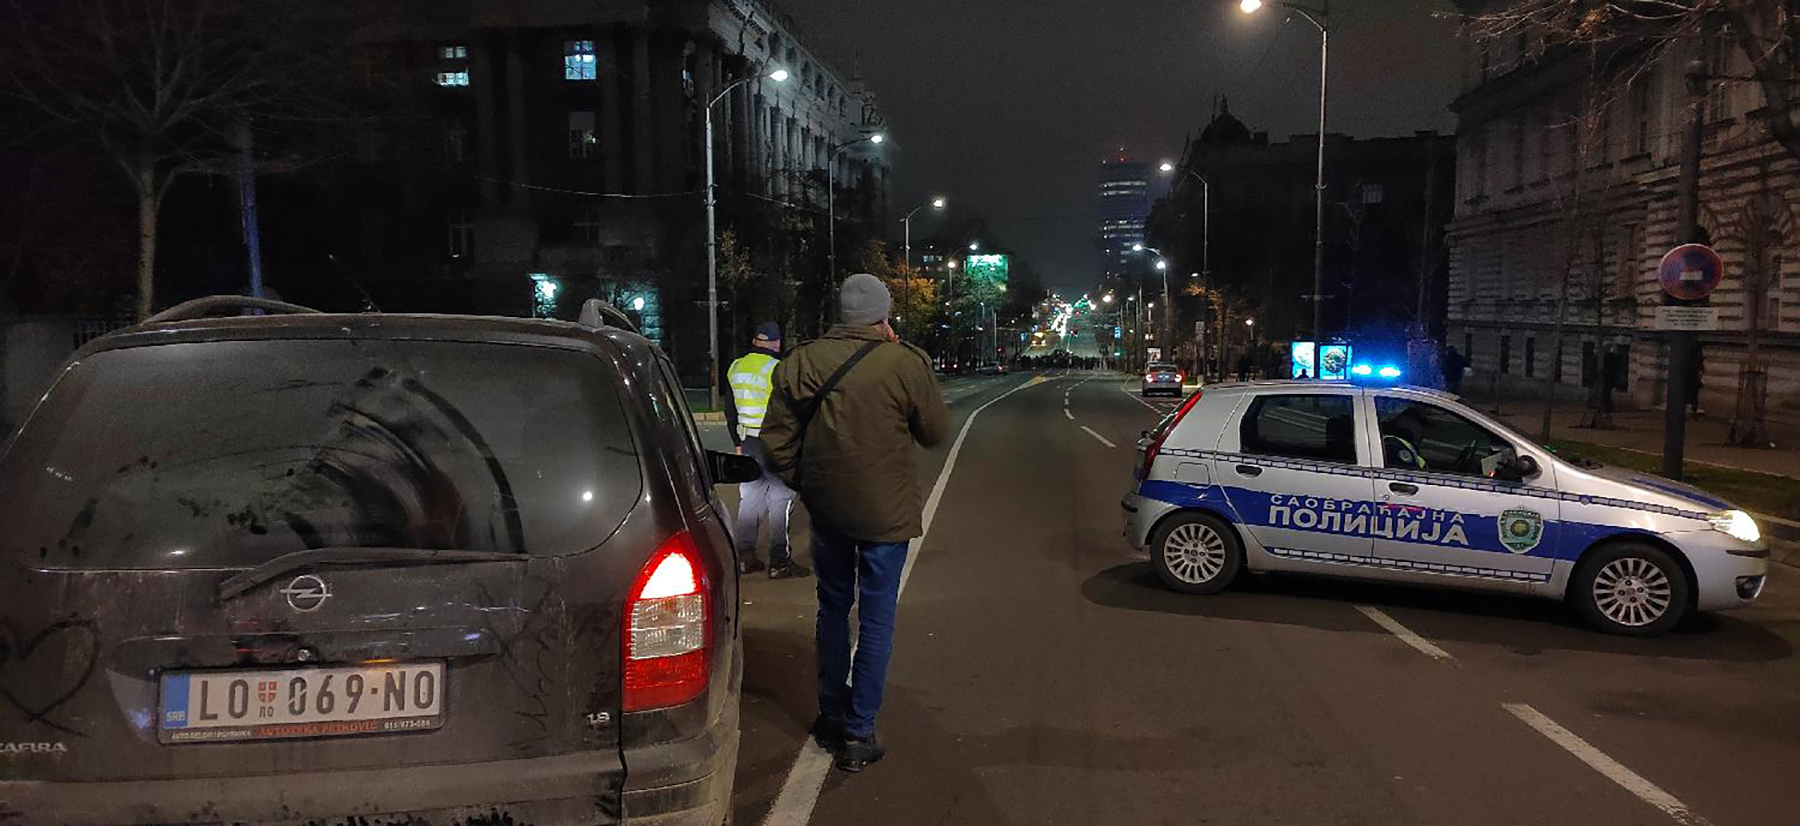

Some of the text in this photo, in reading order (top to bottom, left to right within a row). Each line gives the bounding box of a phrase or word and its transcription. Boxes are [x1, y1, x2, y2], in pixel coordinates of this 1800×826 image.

[1269, 506, 1469, 546] ПОЛИЦИЈА
[1270, 494, 1464, 524] САОБРАЋАЈНА
[167, 711, 185, 721] SRB
[200, 679, 249, 720] LO
